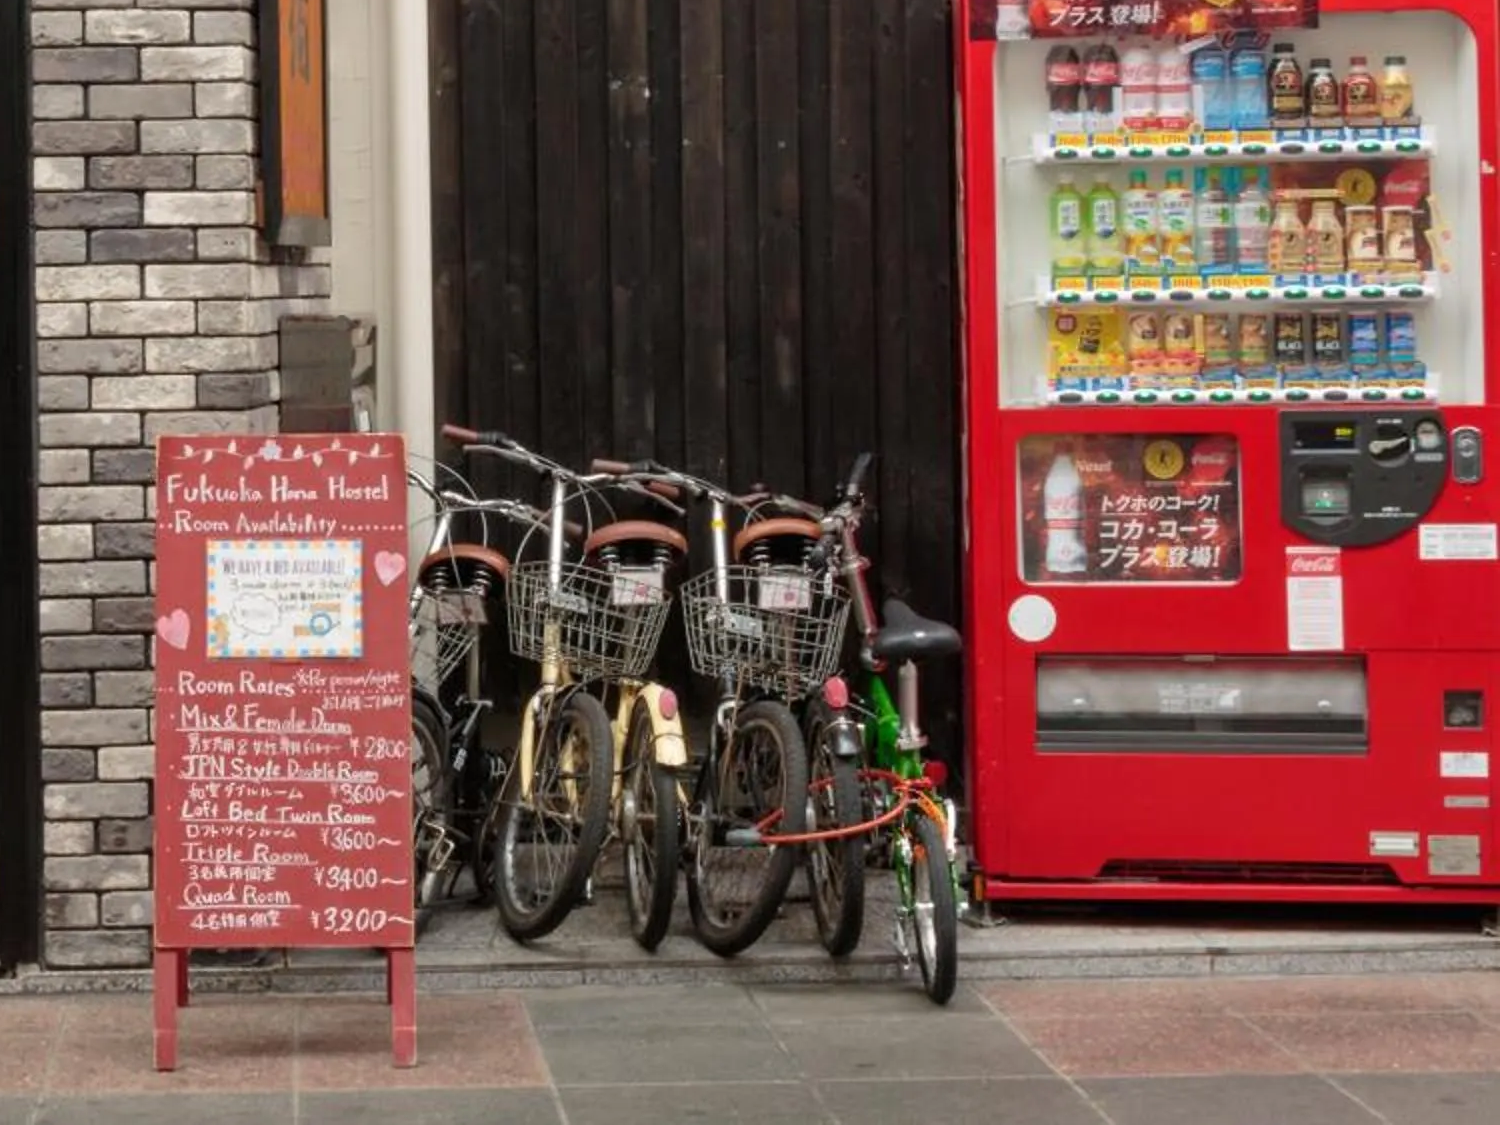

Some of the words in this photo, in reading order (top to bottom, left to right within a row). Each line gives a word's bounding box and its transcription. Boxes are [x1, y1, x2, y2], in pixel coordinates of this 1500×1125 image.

[166, 473, 263, 504] Fukuoka
[271, 474, 318, 503] Hana
[328, 474, 389, 502] Hostel
[1101, 494, 1220, 513] トクホのコーク!
[174, 510, 230, 535] Room
[235, 511, 338, 537] Availability
[1100, 519, 1220, 540] コカ・コーラ
[178, 670, 234, 696] Room
[239, 670, 296, 698] Rates
[243, 703, 307, 731] Female
[311, 706, 353, 733] Dorm
[183, 754, 226, 778] JPN
[231, 758, 281, 784] Style
[181, 801, 219, 820] Loft
[228, 803, 269, 823] Bed
[275, 805, 323, 824] Twin
[327, 803, 377, 825] Room
[181, 842, 245, 865] Triple
[252, 843, 312, 865] Room
[183, 883, 237, 906] Quad
[243, 885, 292, 905] Room
